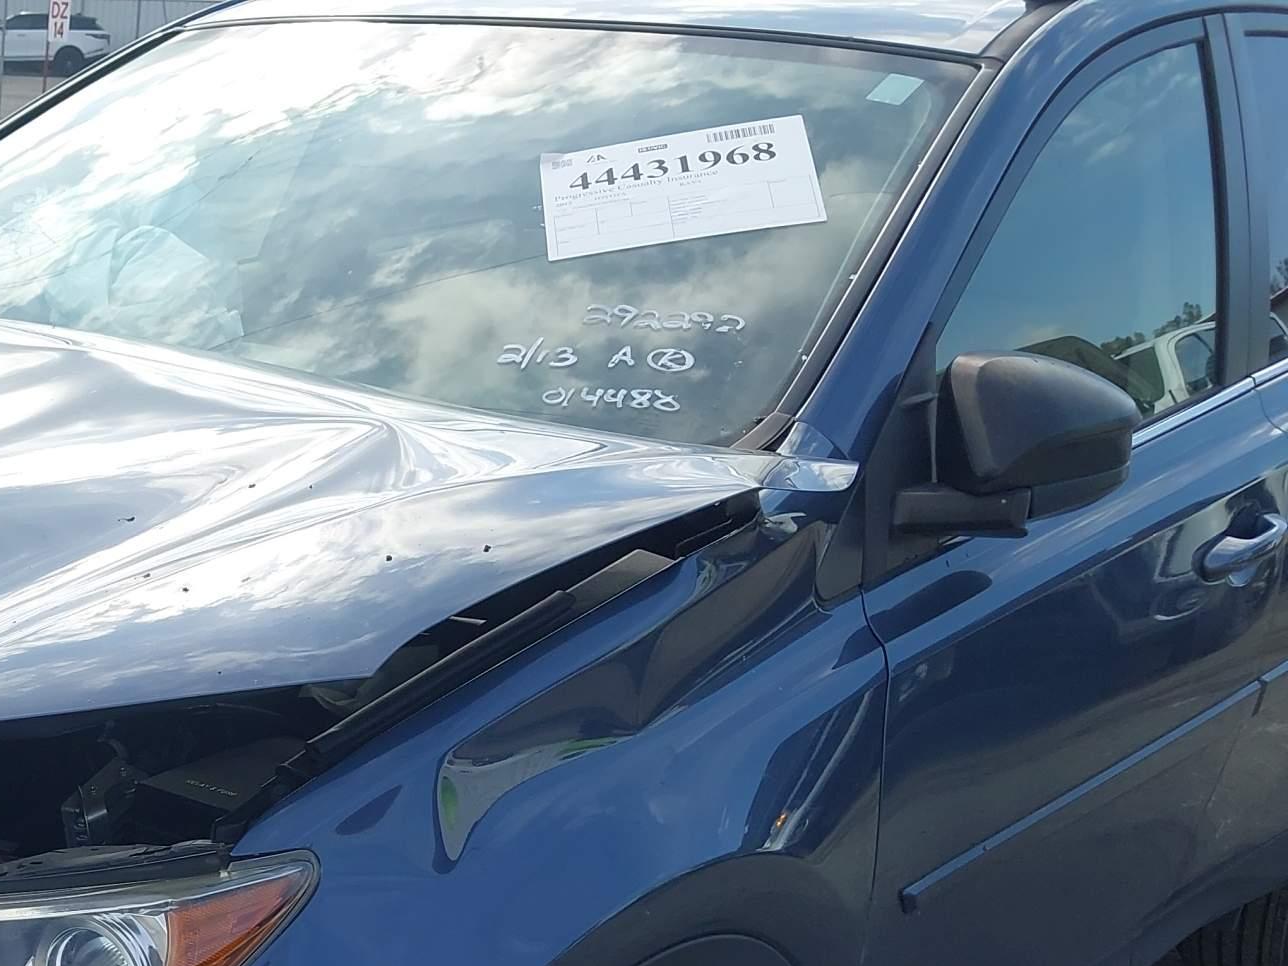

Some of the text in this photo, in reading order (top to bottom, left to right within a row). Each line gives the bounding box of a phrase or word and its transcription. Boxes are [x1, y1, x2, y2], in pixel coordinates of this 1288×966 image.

[52, 1, 68, 19] DZ
[54, 21, 64, 39] 14
[569, 142, 777, 191] 44431968
[496, 337, 579, 369] 2/13
[608, 345, 635, 368] A
